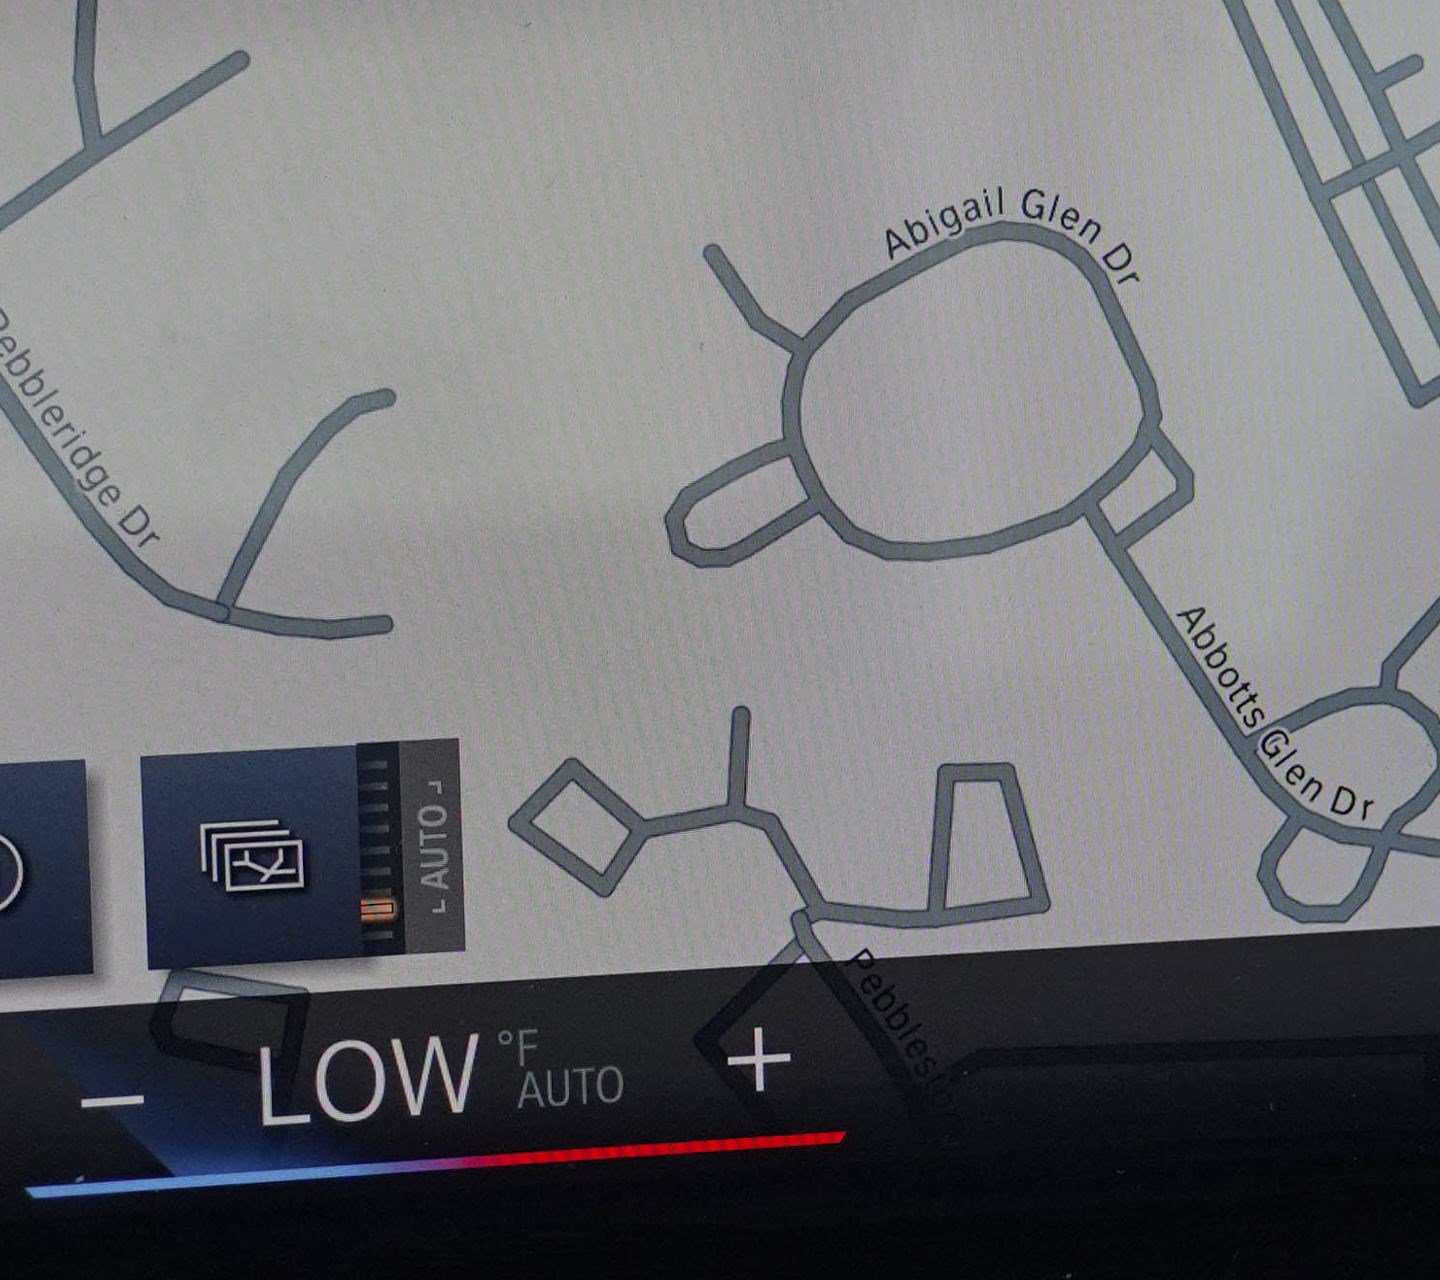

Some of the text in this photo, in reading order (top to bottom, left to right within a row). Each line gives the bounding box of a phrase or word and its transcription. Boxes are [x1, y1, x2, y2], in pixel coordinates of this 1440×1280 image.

[884, 186, 1141, 288] Abigail Glen Dr
[119, 505, 161, 549] Dr
[1176, 605, 1376, 823] Abbotts Glen Dr
[418, 804, 448, 891] AUTO
[260, 1032, 480, 1127] LOW
[517, 1067, 624, 1110] AUTO
